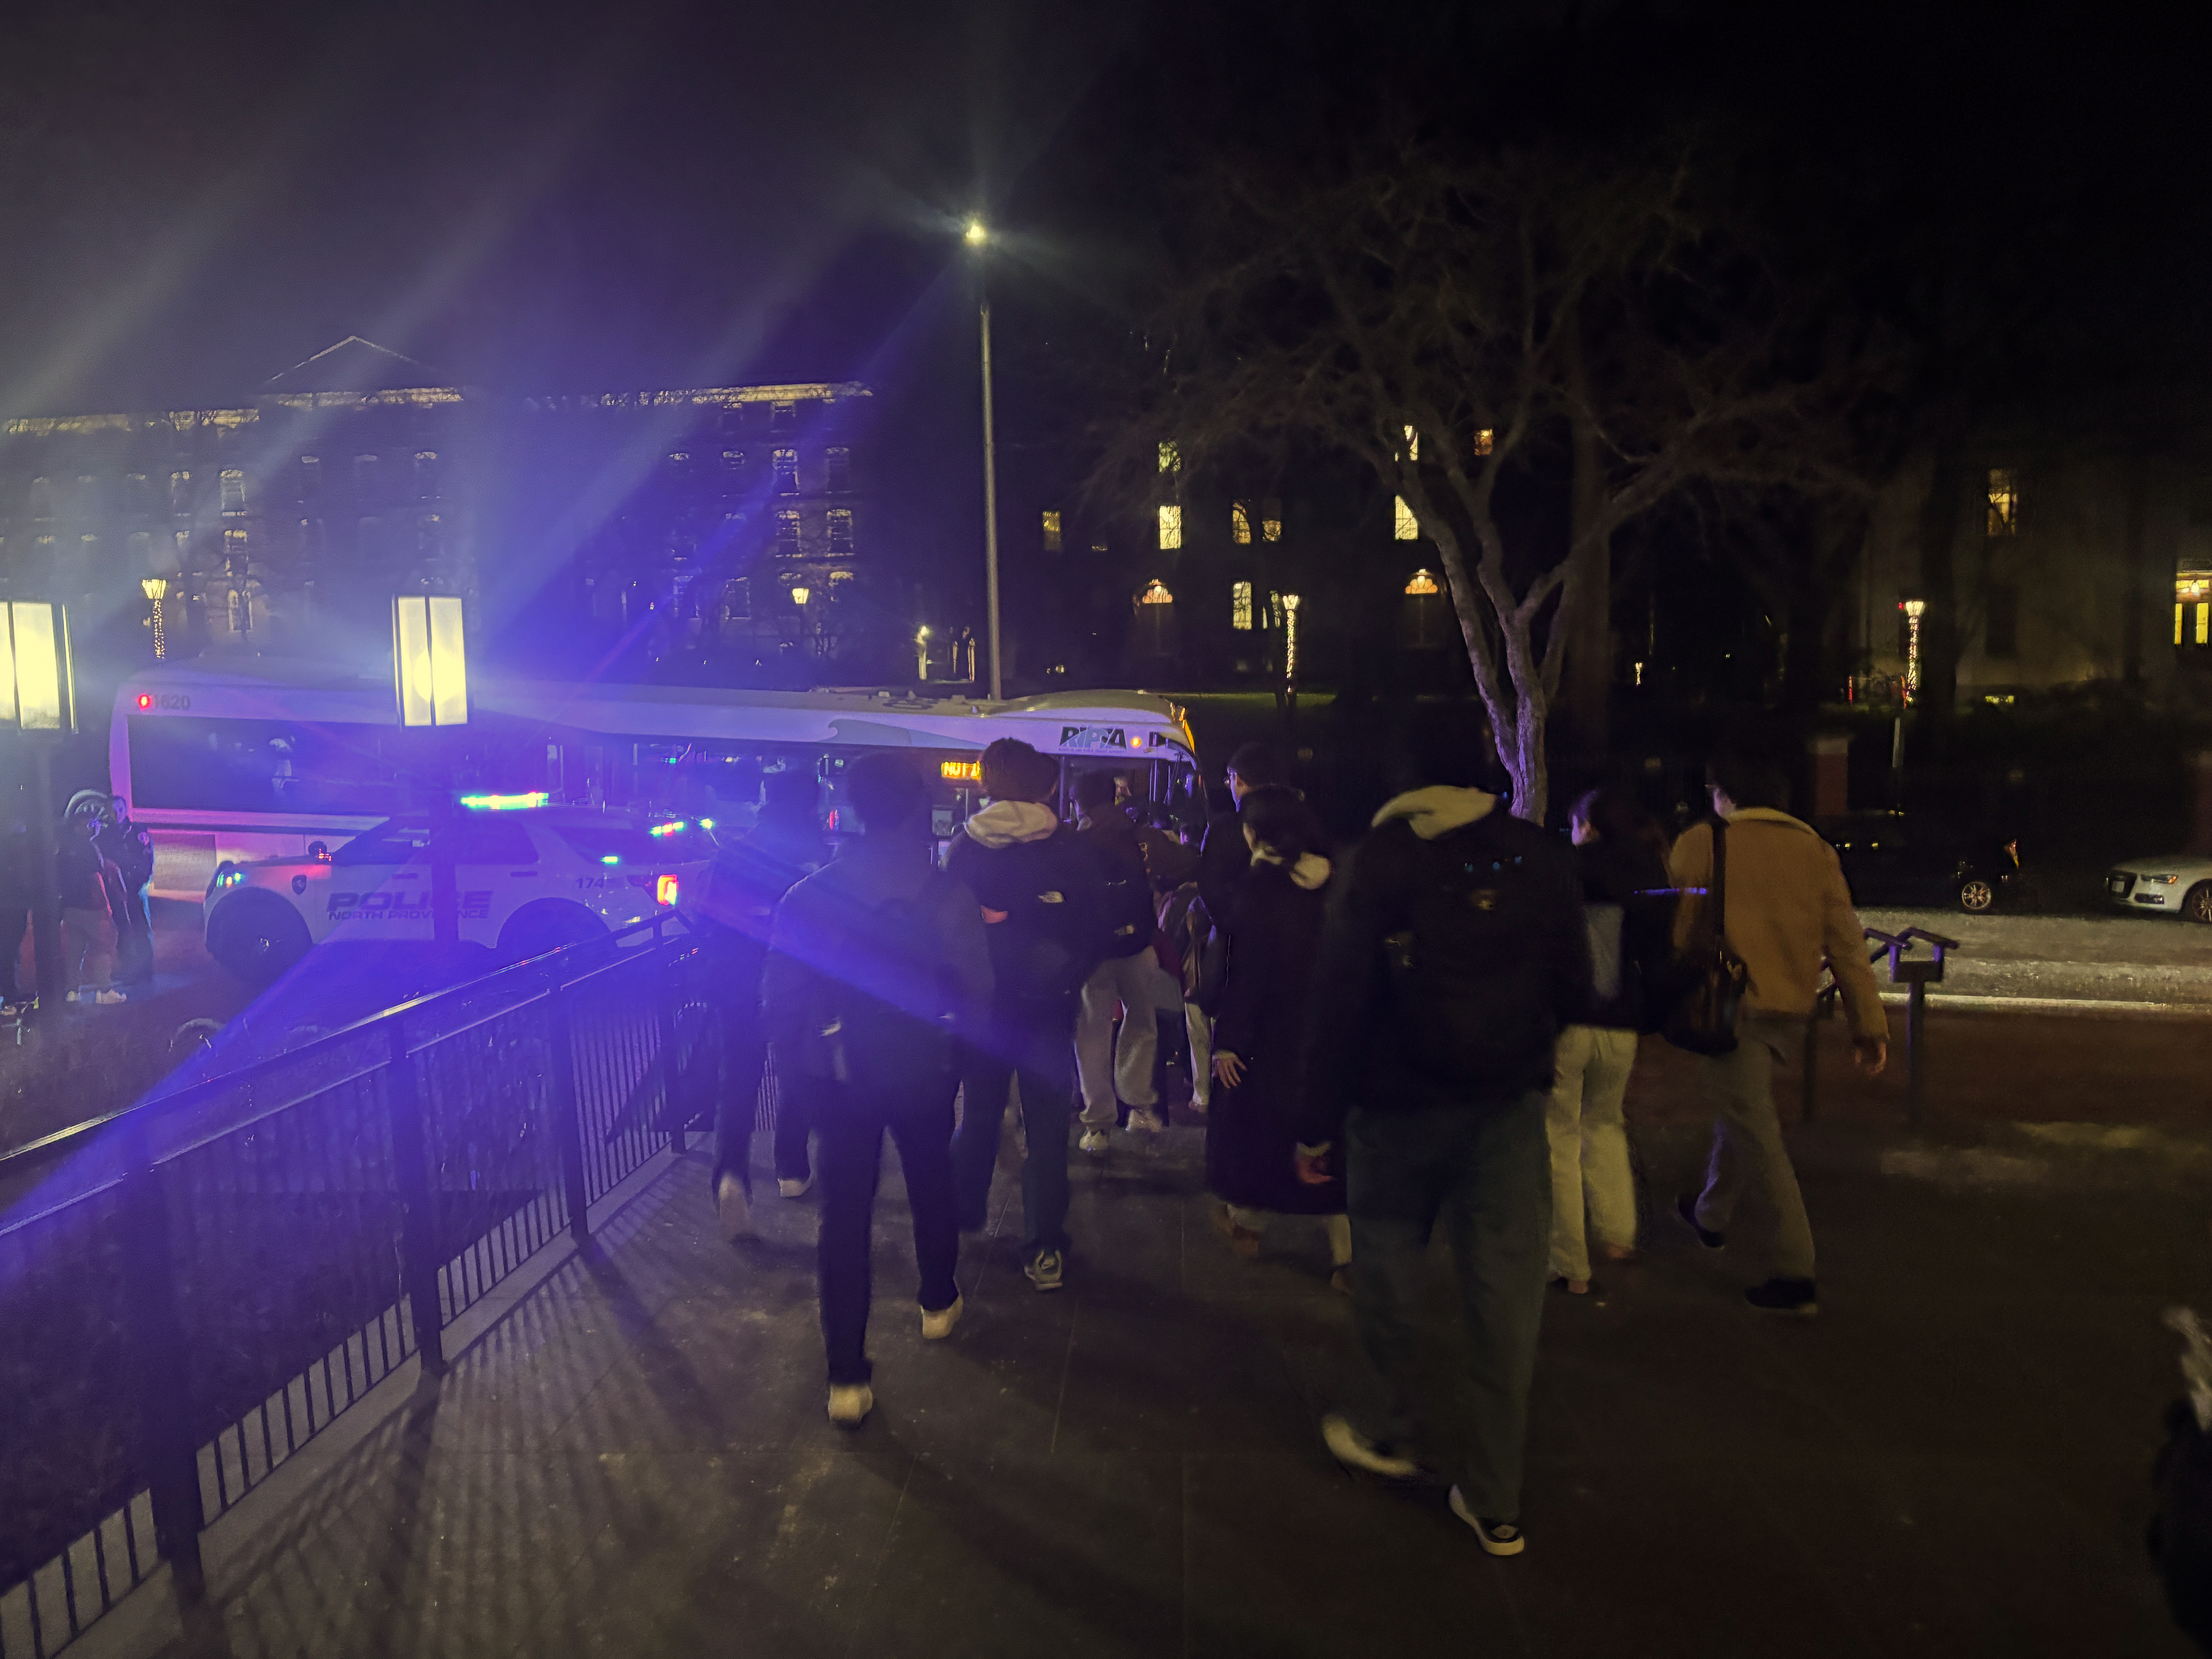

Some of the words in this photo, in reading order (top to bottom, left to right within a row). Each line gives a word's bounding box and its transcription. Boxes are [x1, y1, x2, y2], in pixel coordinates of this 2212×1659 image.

[1059, 726, 1127, 750] RIPTA
[575, 877, 605, 889] 174
[326, 891, 494, 912] POLIE
[328, 910, 383, 920] NORTH
[388, 910, 489, 919] PROVNCE
